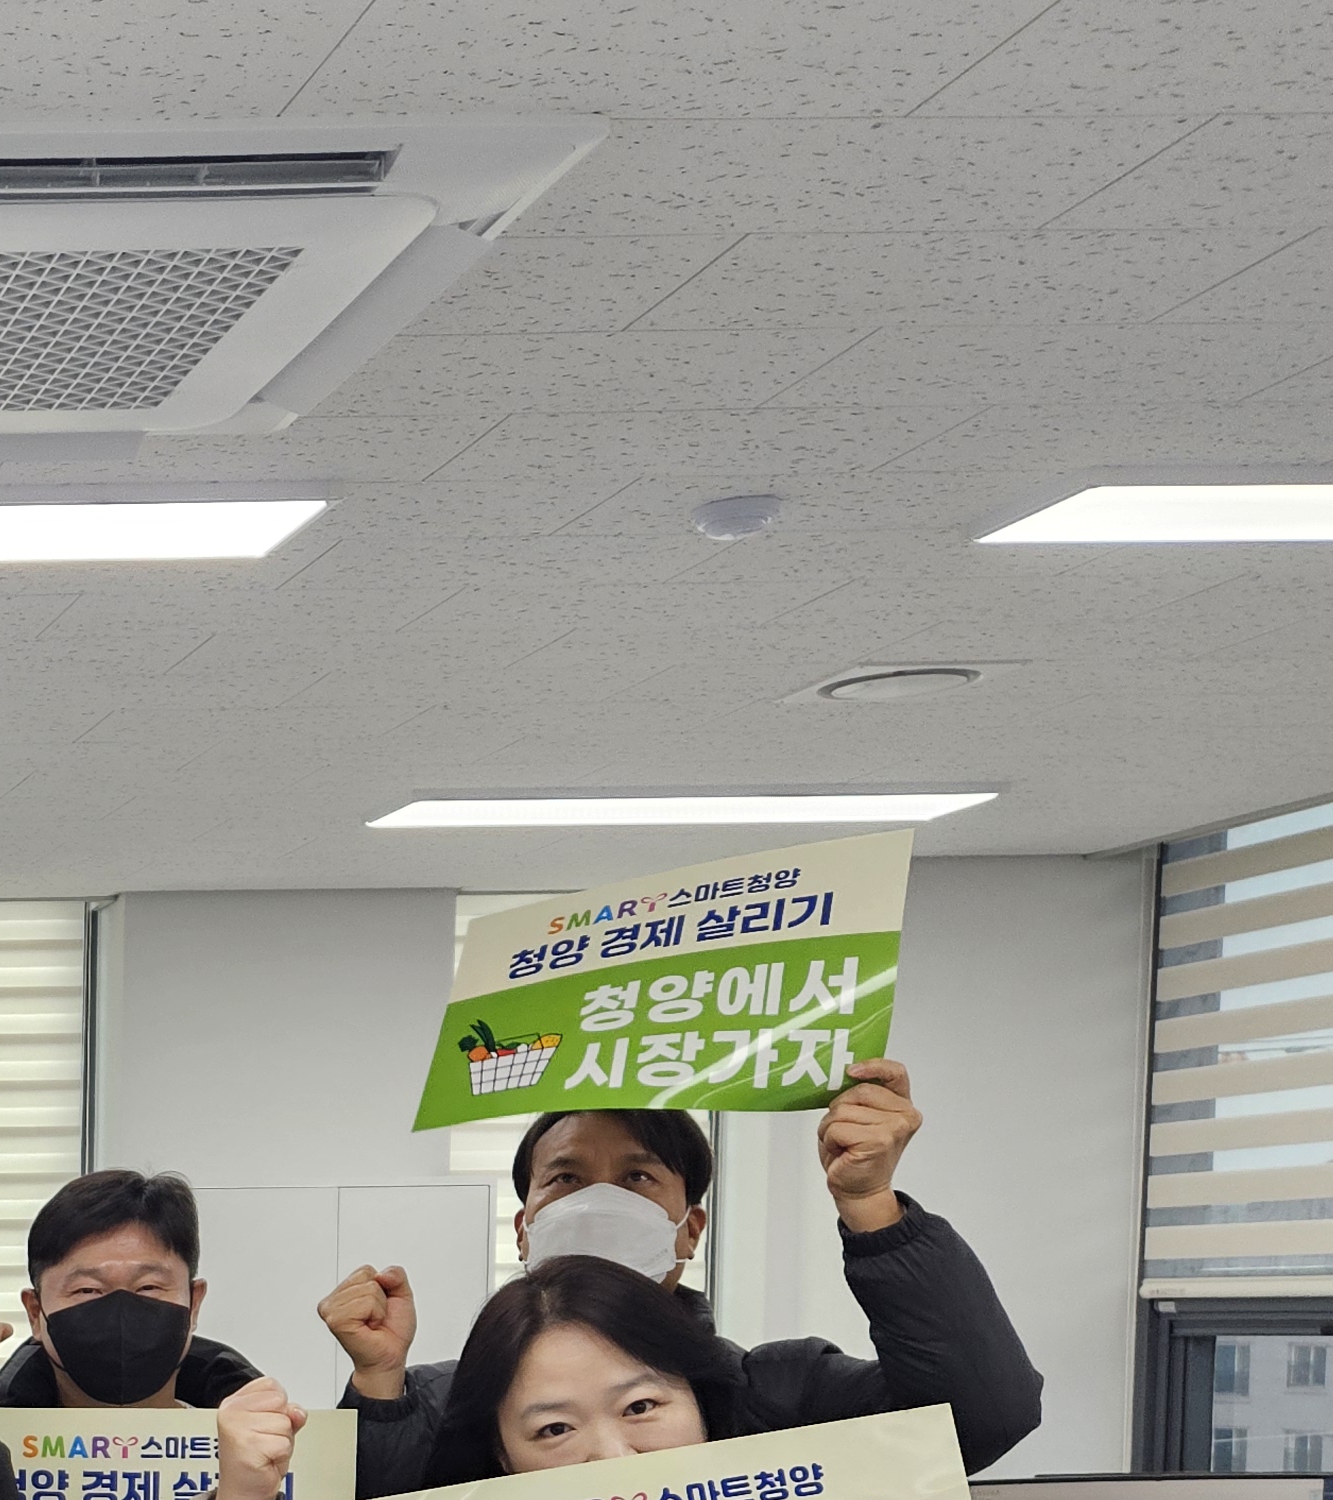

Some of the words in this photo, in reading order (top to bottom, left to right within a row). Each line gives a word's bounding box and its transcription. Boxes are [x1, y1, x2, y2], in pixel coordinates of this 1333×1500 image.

[667, 867, 802, 909] 스마트청양
[508, 937, 590, 980] 청양
[600, 914, 684, 959] 경제
[696, 892, 834, 943] 살리기
[579, 956, 860, 1033] 청양에서
[563, 1028, 854, 1091] 시장가자
[140, 1436, 219, 1459] 스마트
